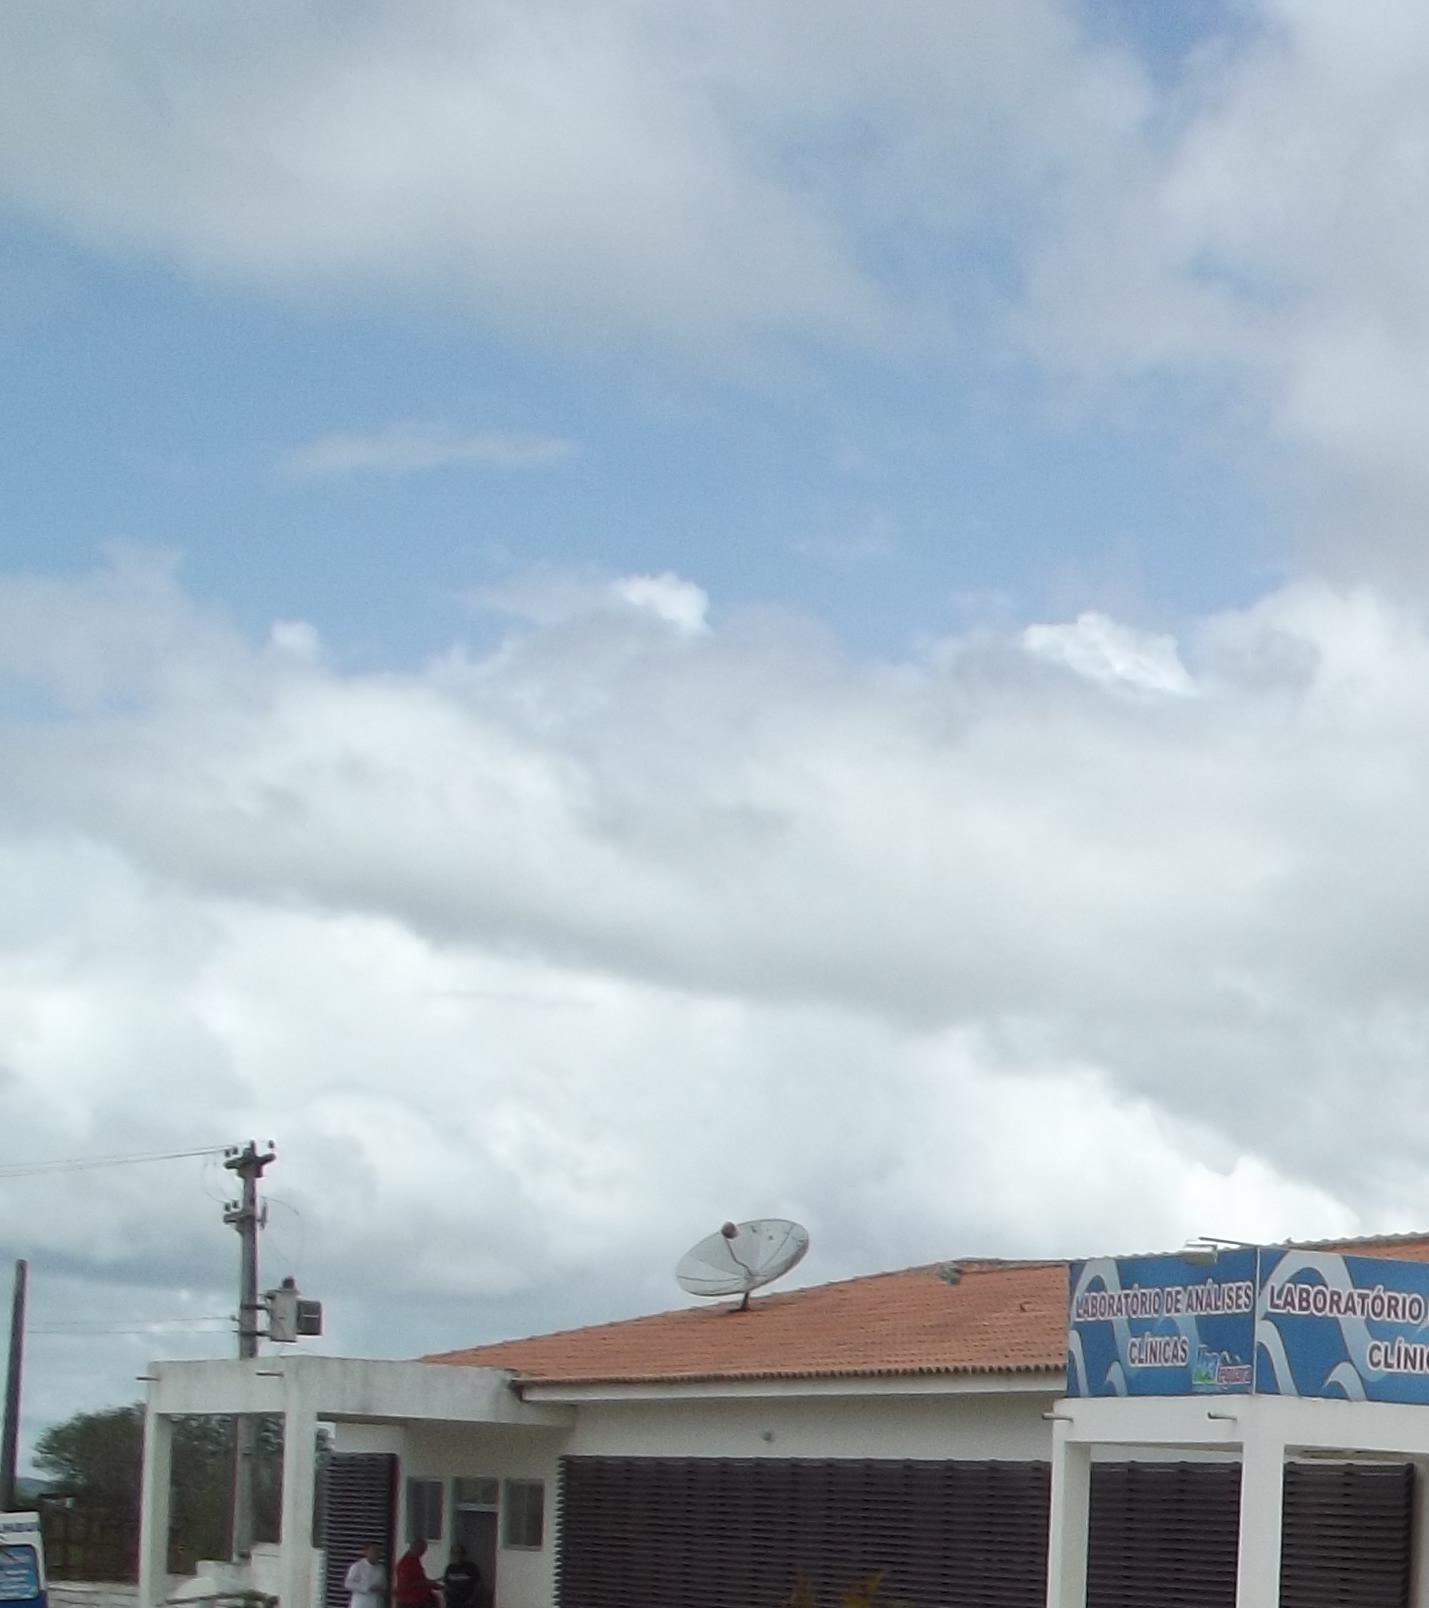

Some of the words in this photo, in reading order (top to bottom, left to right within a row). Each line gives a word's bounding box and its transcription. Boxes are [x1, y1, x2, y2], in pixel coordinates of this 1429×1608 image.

[1075, 1284, 1161, 1320] LABORATÓRIO
[1164, 1288, 1182, 1315] DE
[1185, 1279, 1252, 1314] ANÁLISES
[1268, 1284, 1423, 1323] LABORATÓRIO
[1129, 1333, 1188, 1366] CLÍNICAS
